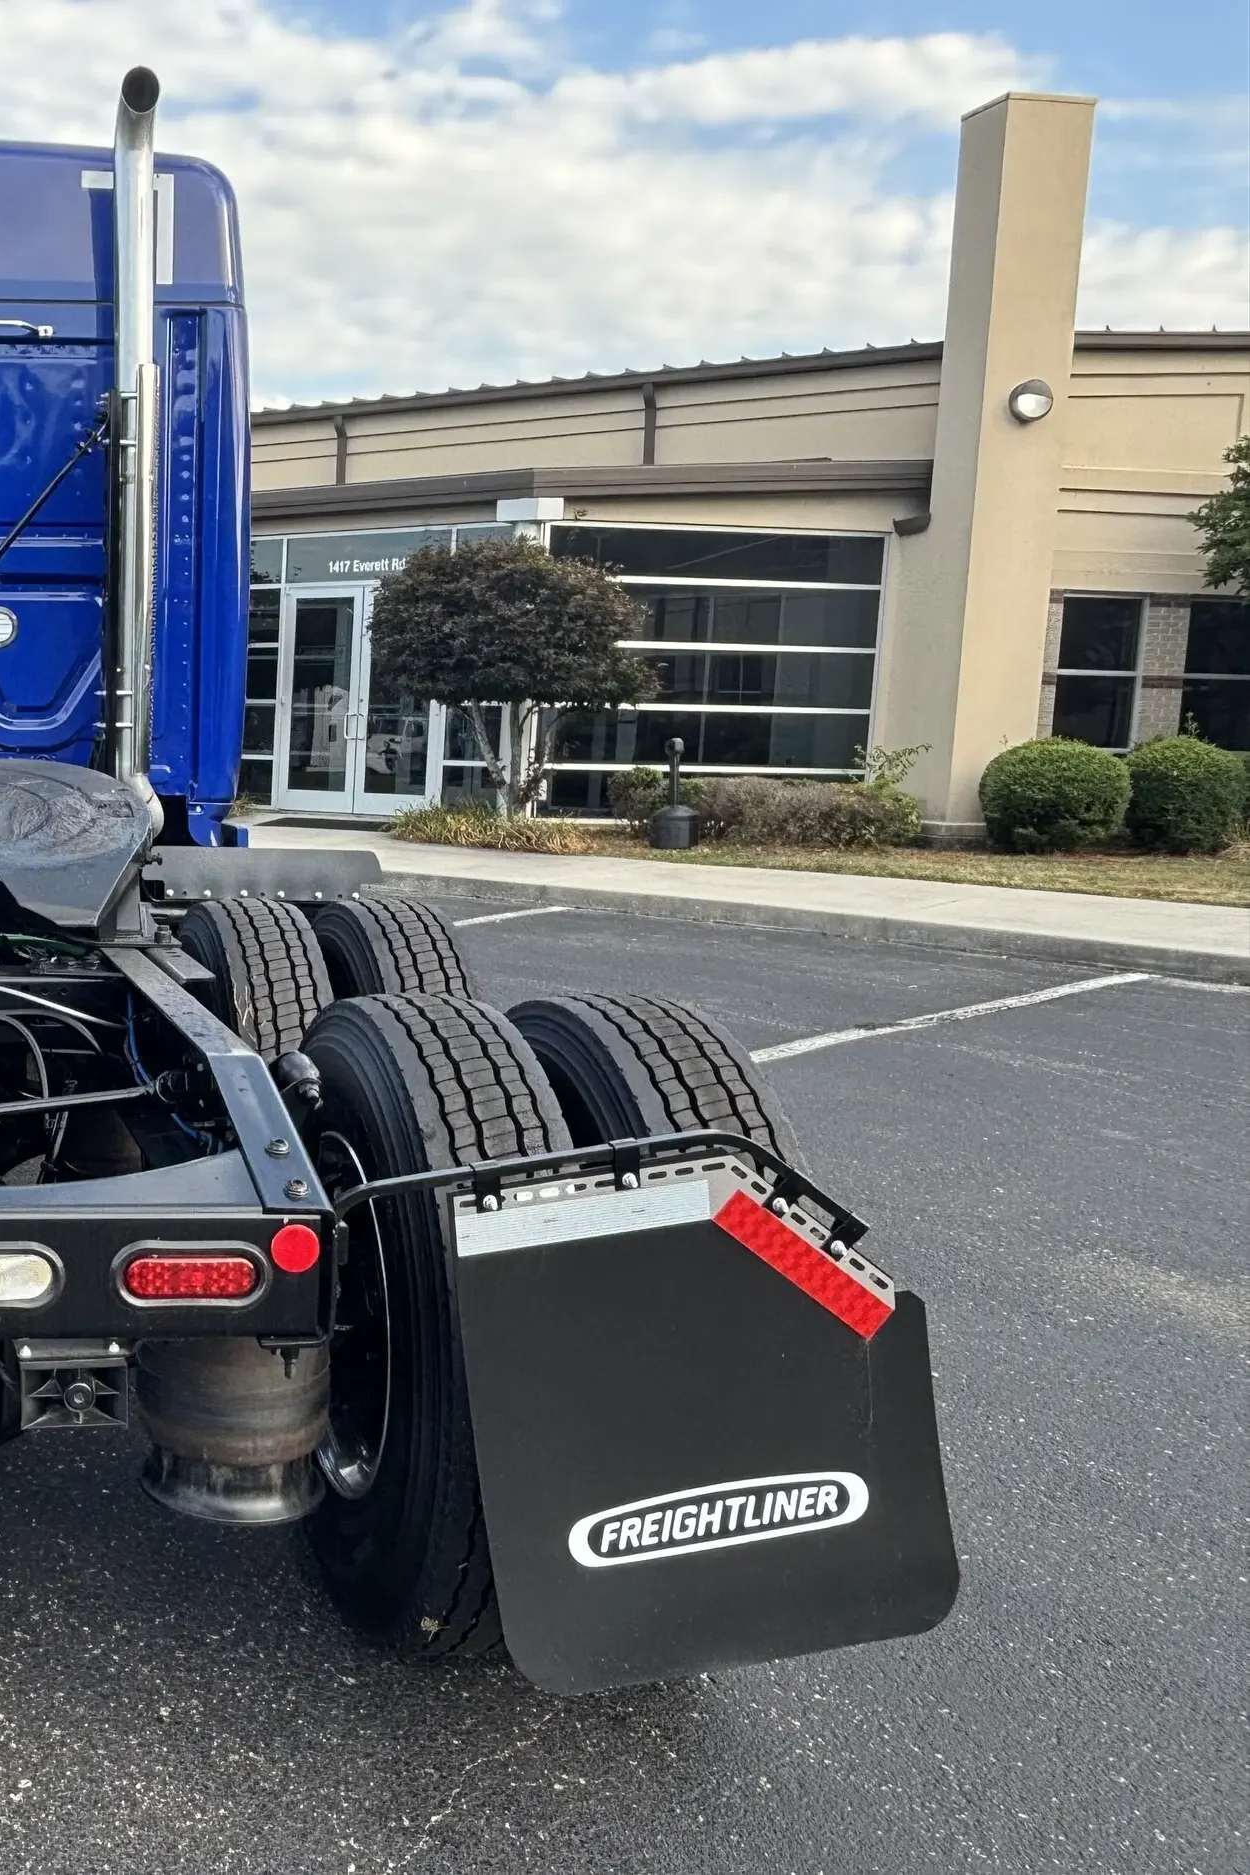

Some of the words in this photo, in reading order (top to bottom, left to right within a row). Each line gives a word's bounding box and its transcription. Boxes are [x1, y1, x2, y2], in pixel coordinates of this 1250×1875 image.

[329, 560, 350, 573] 1417
[353, 558, 389, 572] Everett
[600, 1484, 839, 1553] FREIGHTLINER
